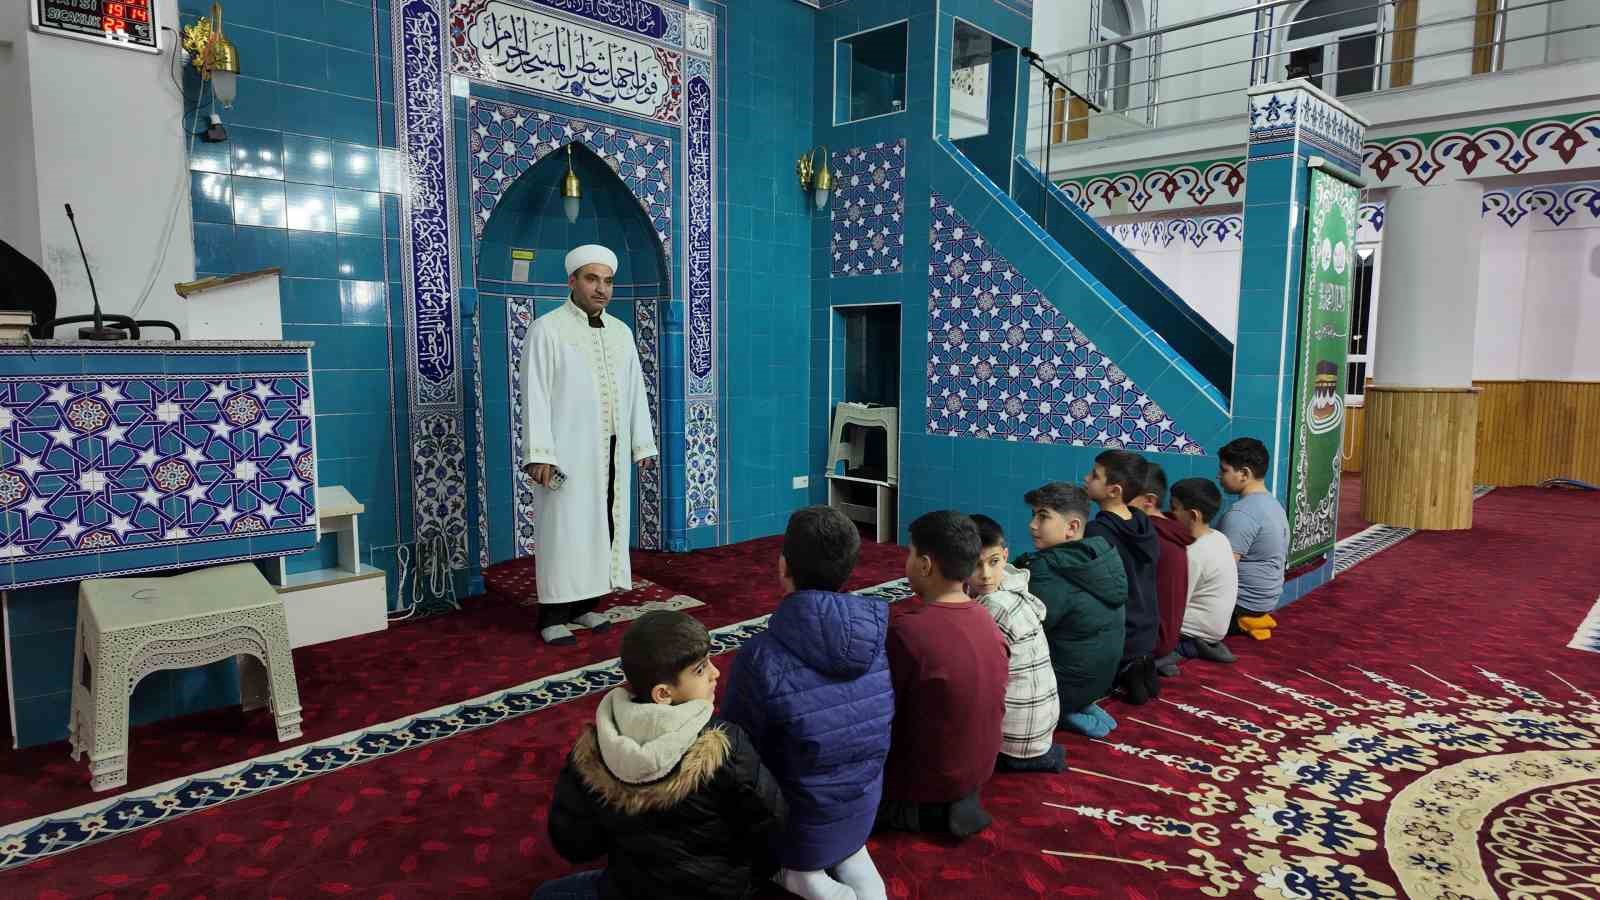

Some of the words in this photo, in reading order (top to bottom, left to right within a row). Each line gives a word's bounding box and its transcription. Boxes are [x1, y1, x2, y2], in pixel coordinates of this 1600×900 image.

[108, 3, 123, 17] 19
[131, 8, 147, 22] 14
[104, 17, 125, 32] 22
